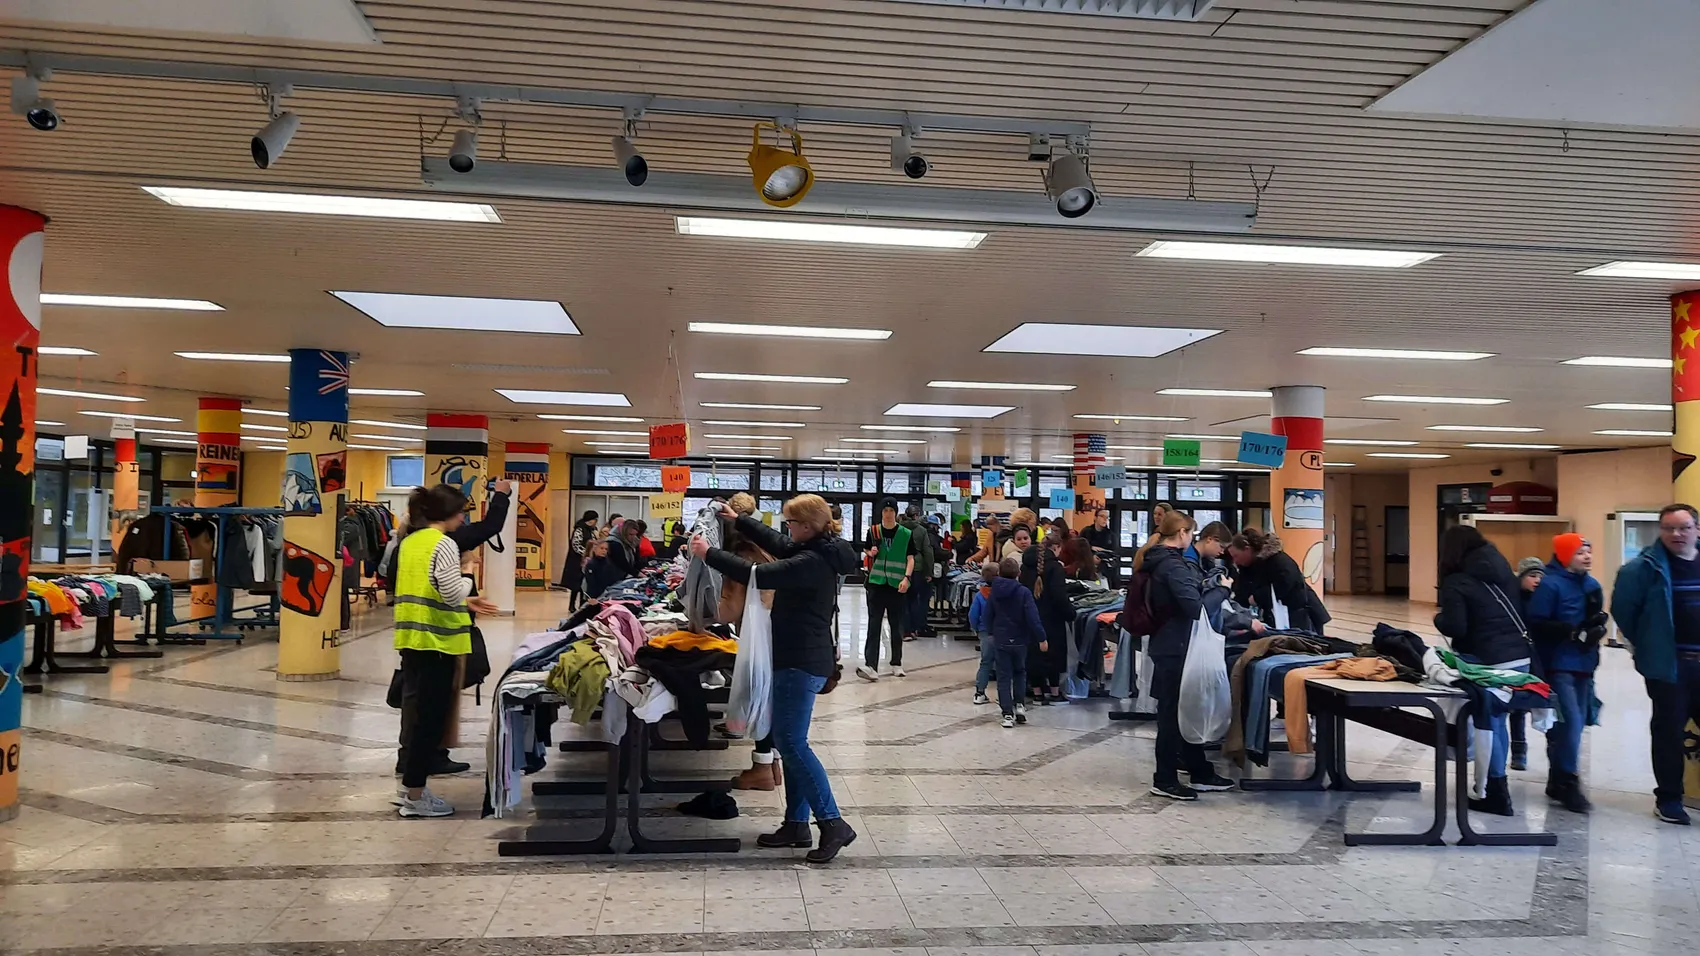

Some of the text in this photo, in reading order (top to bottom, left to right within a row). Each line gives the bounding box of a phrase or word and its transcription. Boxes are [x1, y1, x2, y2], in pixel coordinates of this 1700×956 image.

[651, 435, 686, 447] 170/176
[1165, 449, 1199, 458] 158/164
[1242, 442, 1283, 457] 170/176
[669, 473, 684, 482] 140
[1097, 472, 1125, 481] 146/152
[651, 501, 680, 510] 146/152
